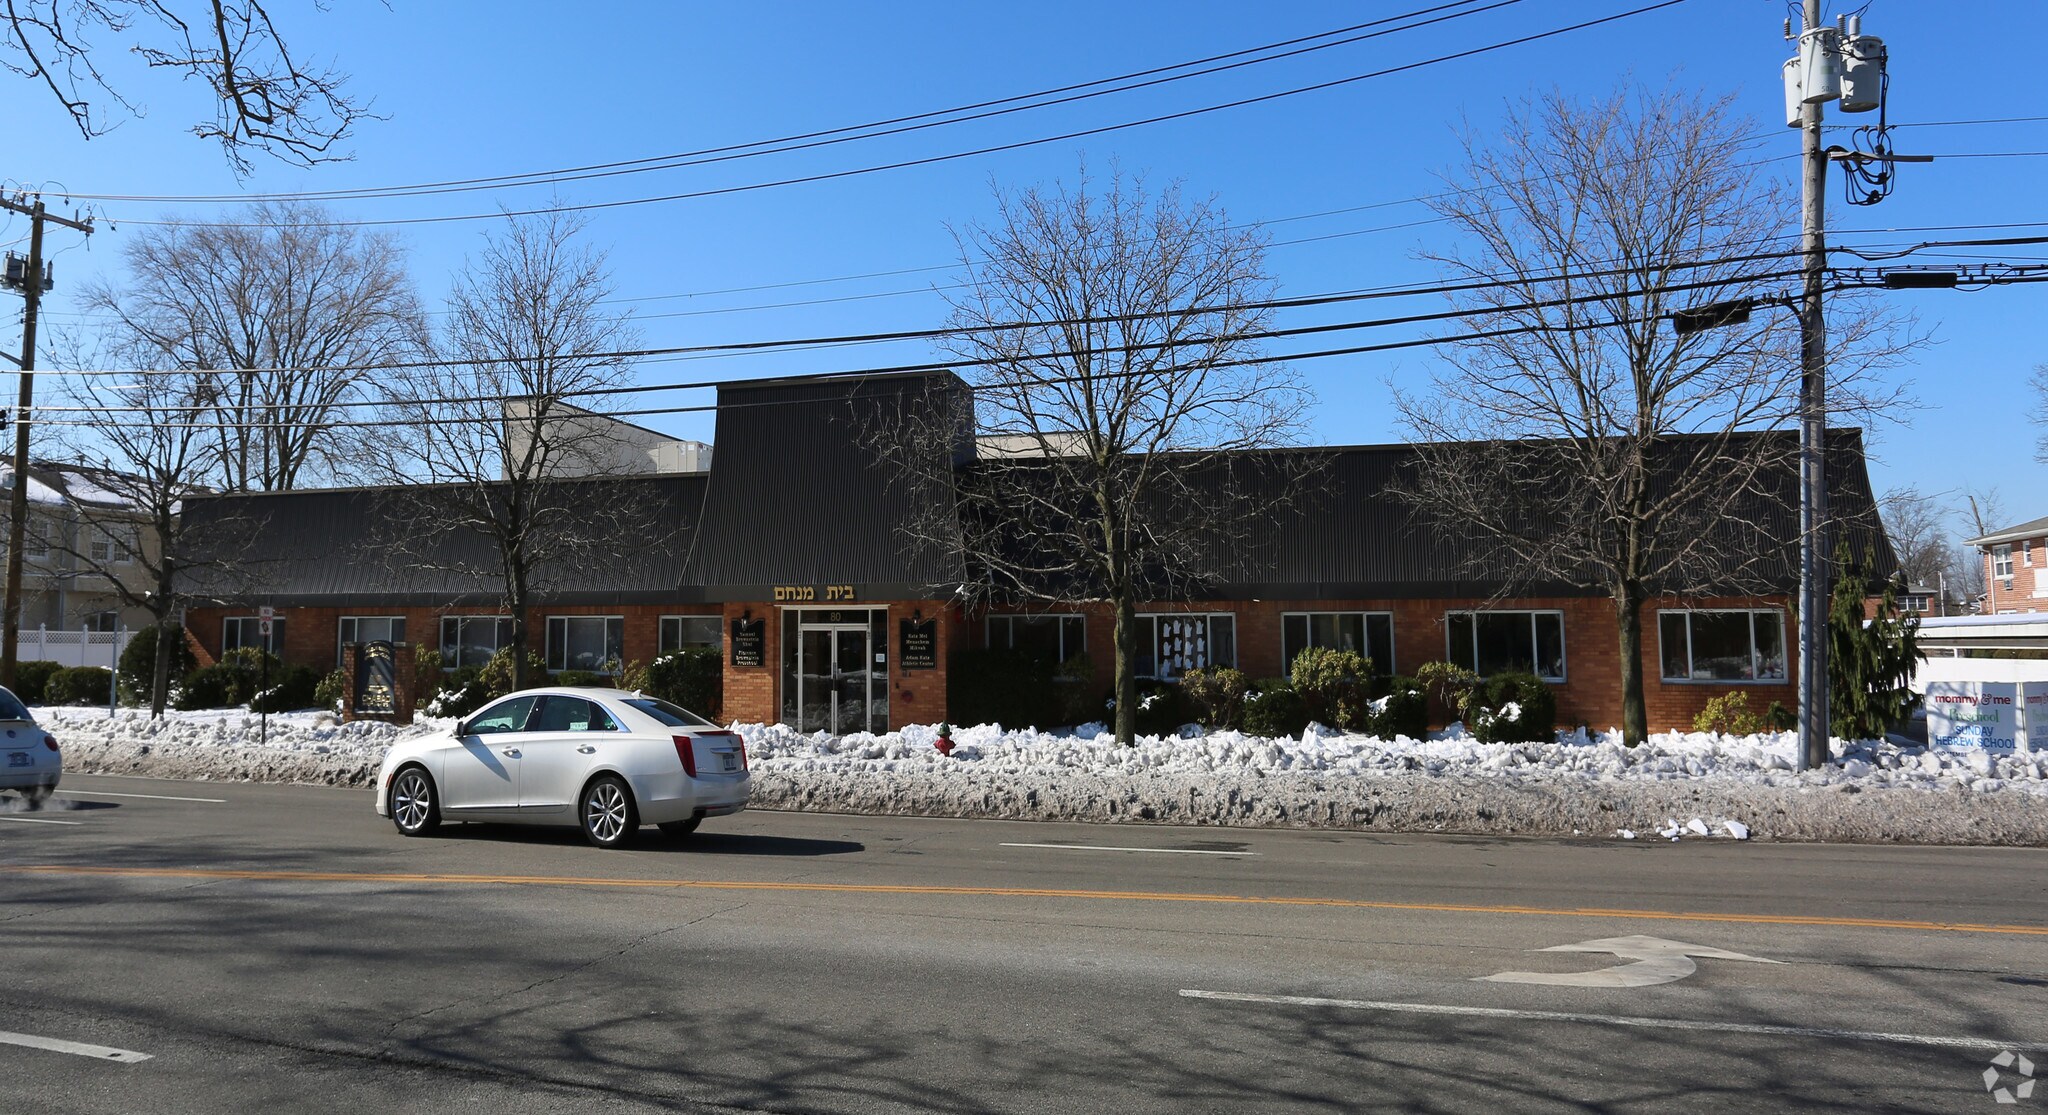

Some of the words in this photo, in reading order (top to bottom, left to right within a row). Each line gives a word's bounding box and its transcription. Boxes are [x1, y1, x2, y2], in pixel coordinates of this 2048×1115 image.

[774, 586, 814, 601] מנחם
[826, 585, 854, 600] בית
[830, 612, 841, 622] 80
[1935, 695, 1978, 706] mommy
[1980, 693, 1992, 705] &
[1993, 696, 2011, 705] me
[1949, 708, 1999, 723] Preschool
[1955, 725, 1993, 737] SUNDAY
[1935, 735, 1973, 747] HEBREW
[1977, 737, 2017, 749] SCHOOL
